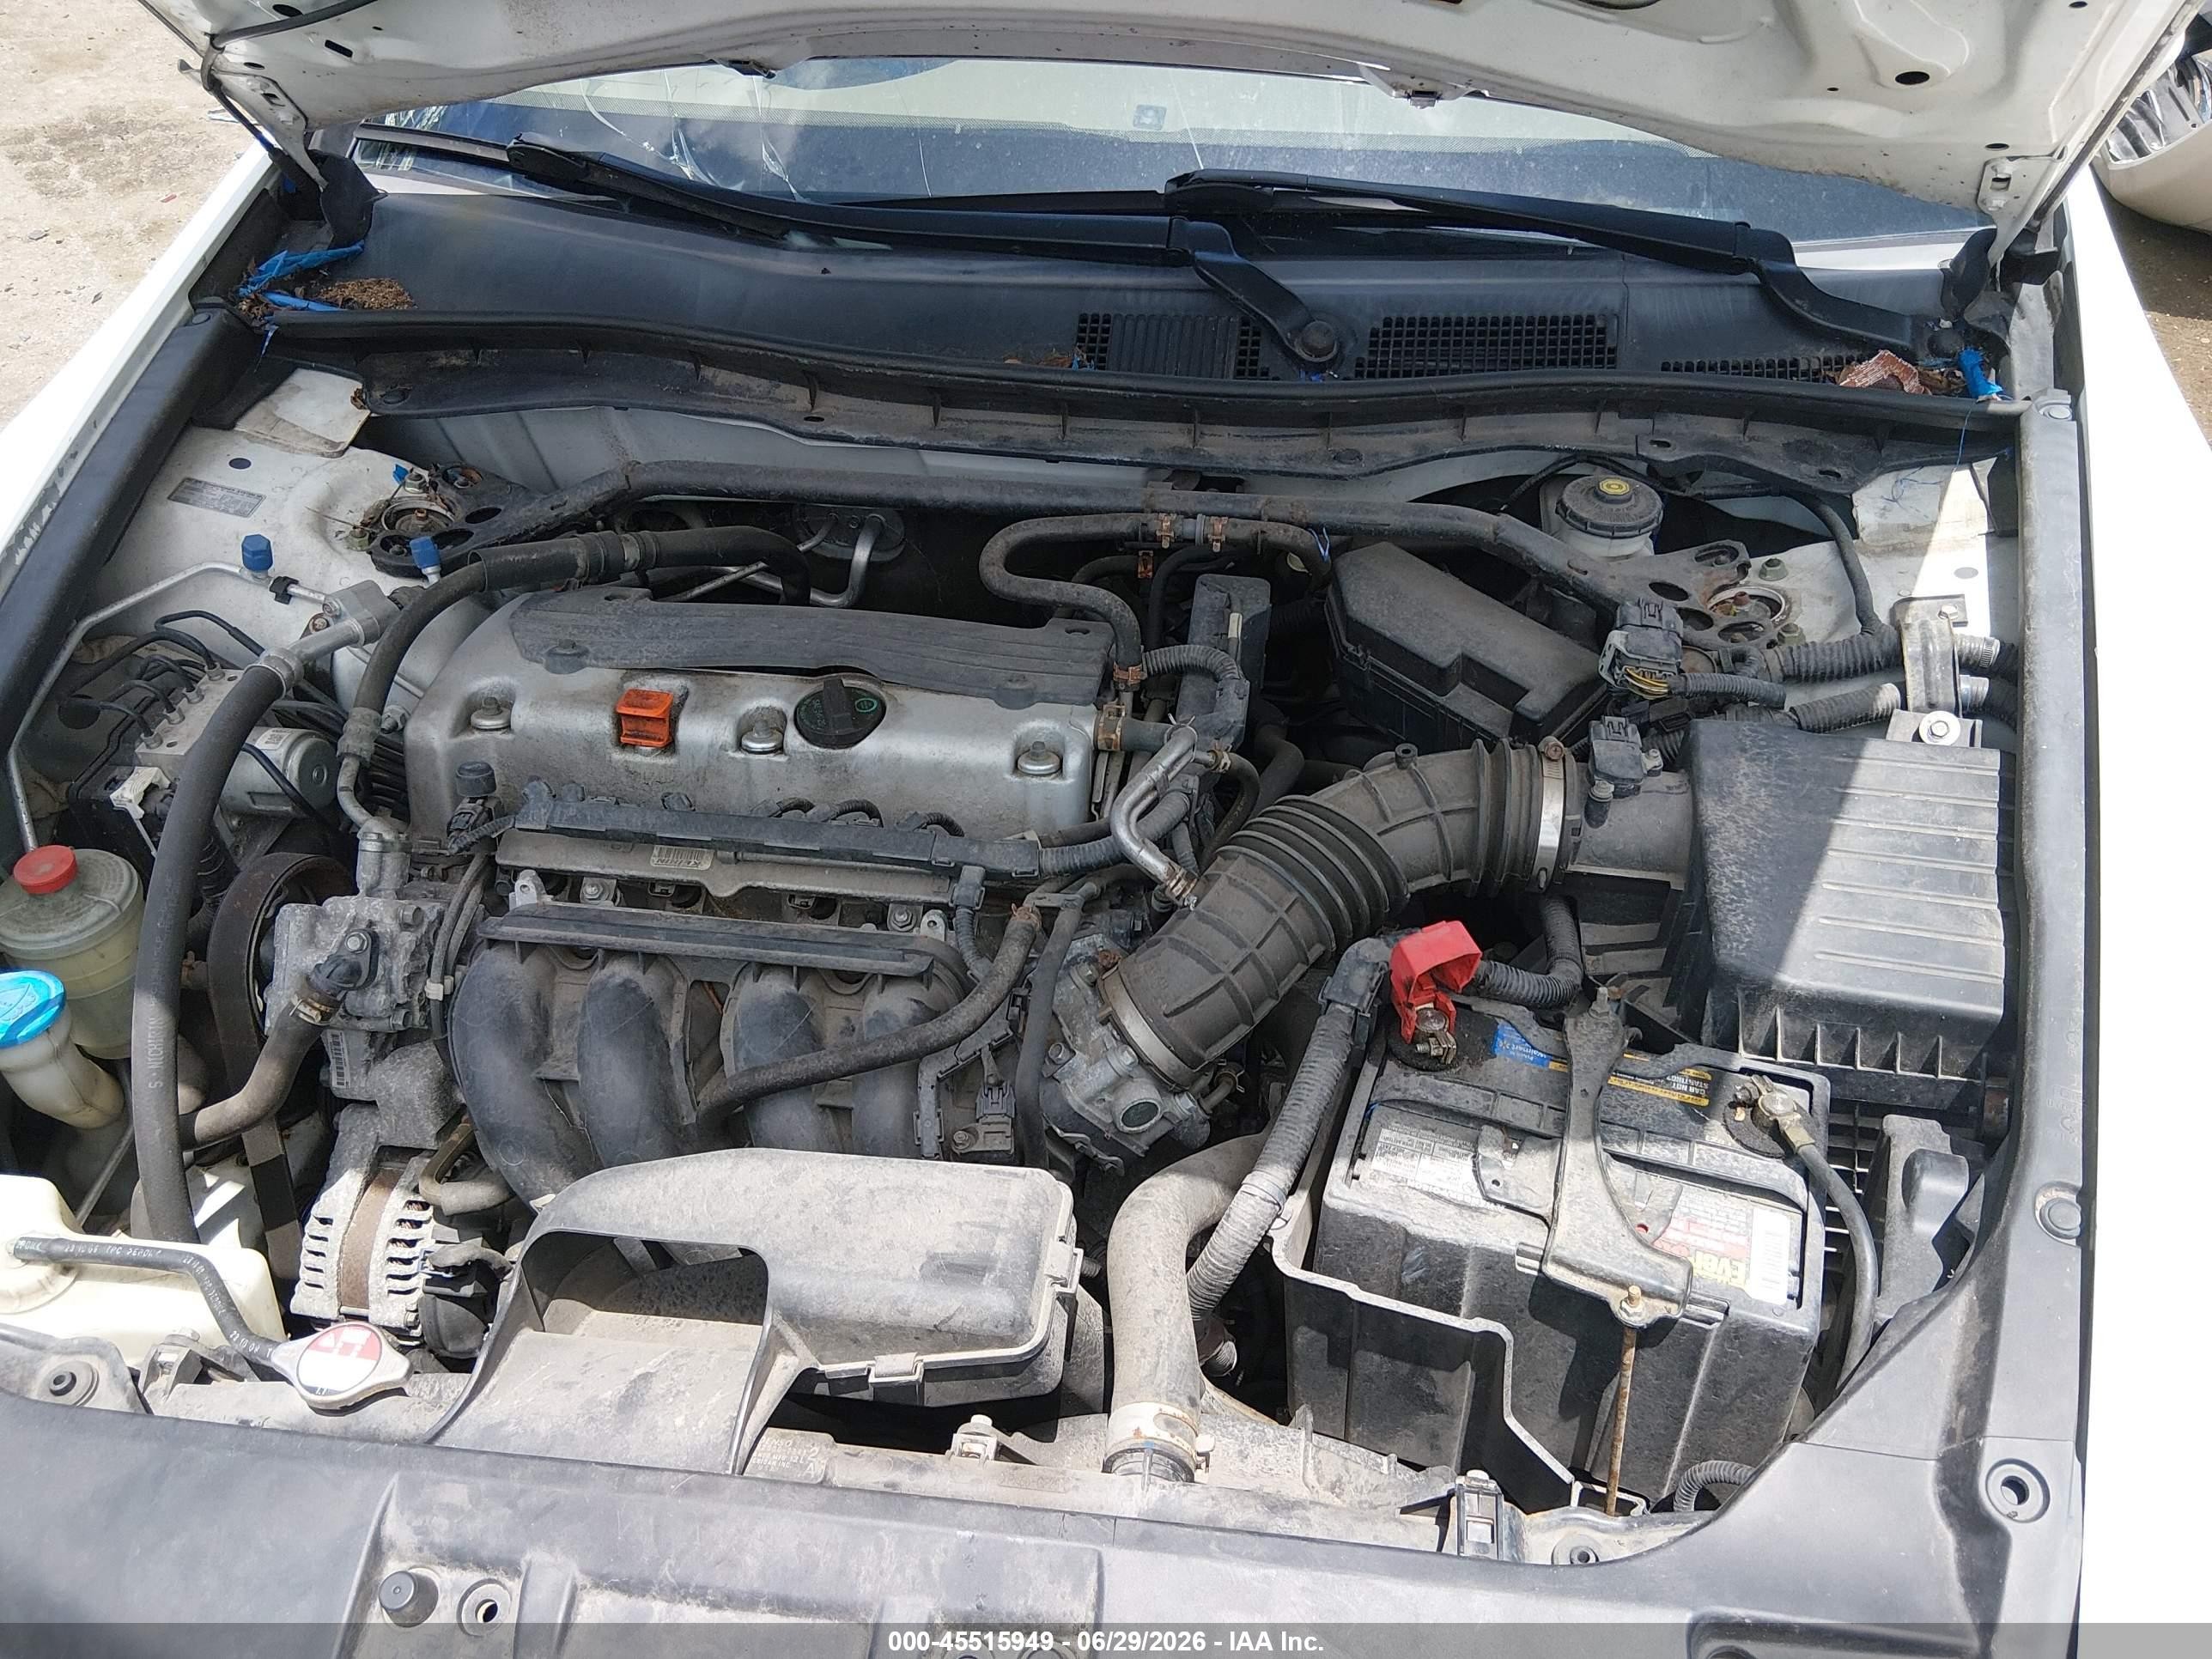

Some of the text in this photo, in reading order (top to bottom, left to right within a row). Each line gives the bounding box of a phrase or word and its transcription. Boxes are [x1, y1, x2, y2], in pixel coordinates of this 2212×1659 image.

[148, 1017, 164, 1070] NICHIRIN
[1511, 1042, 1547, 1059] Walmart
[1666, 1074, 1709, 1090] STARTING?
[1671, 1080, 1706, 1095] CAR NOT
